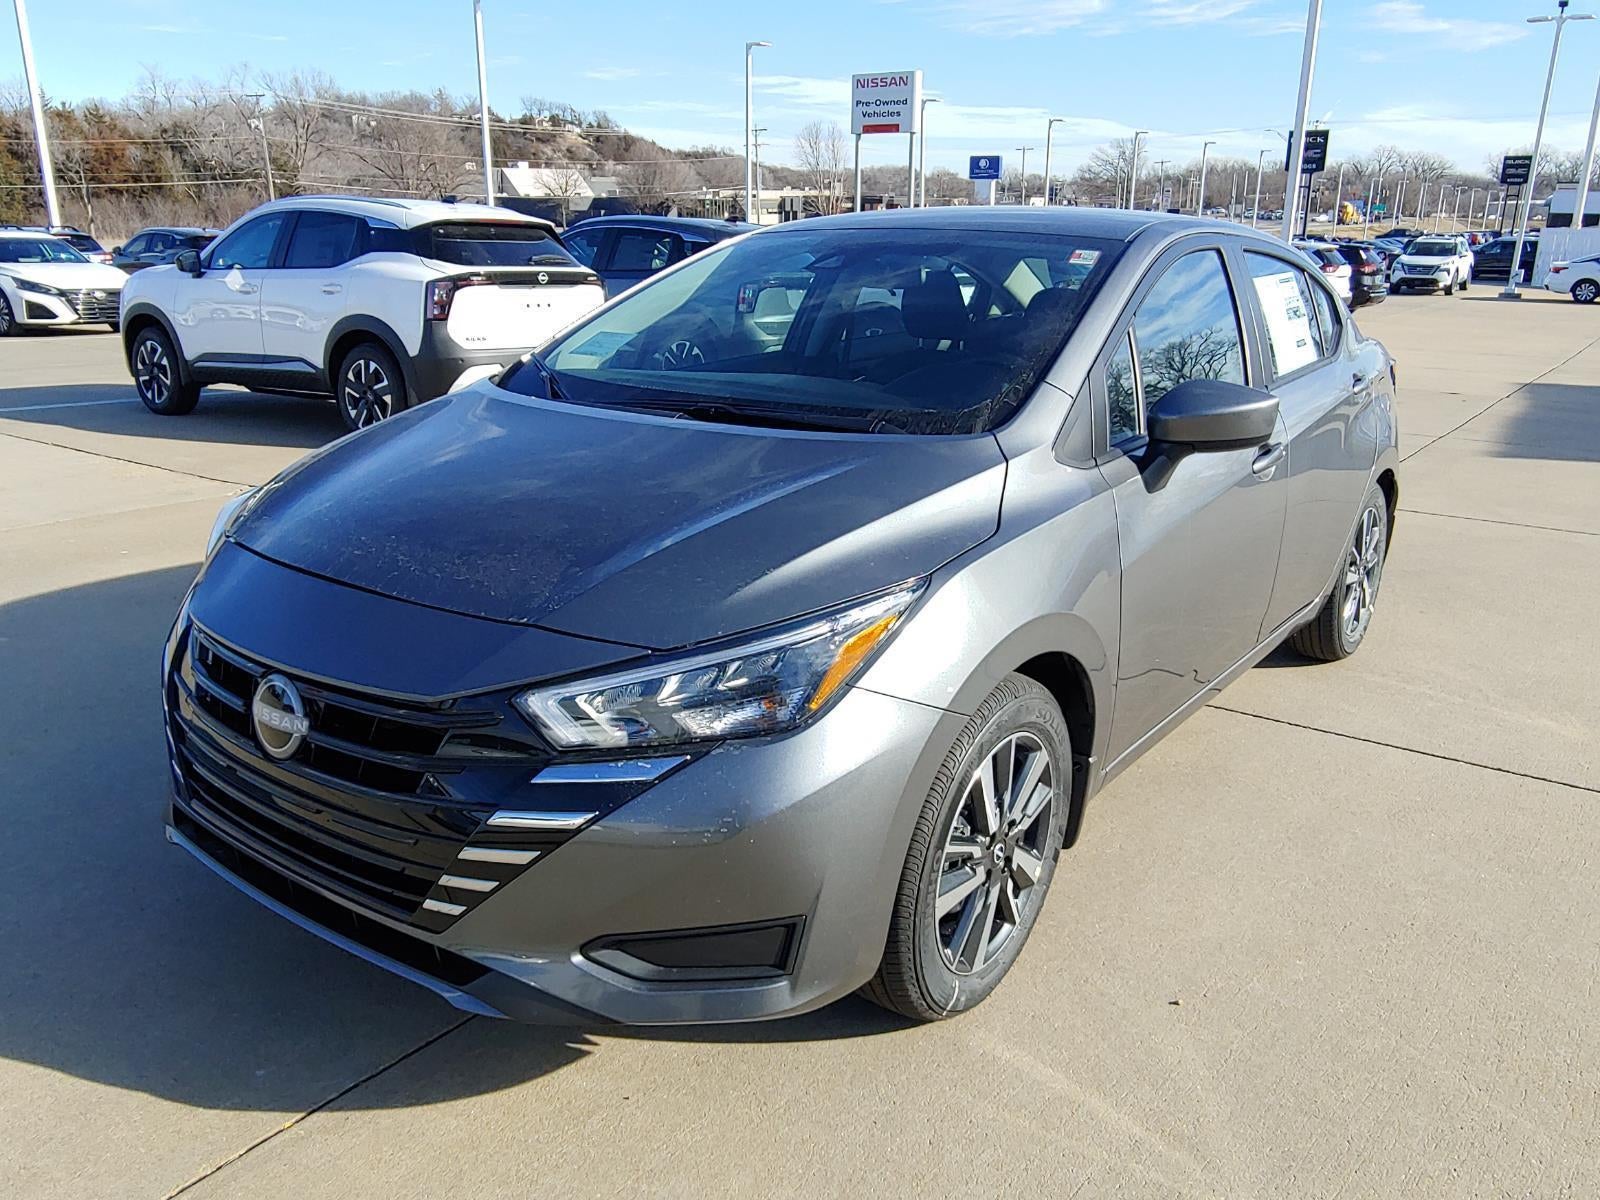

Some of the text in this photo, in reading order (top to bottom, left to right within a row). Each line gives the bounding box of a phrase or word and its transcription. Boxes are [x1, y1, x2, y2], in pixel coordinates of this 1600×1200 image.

[856, 76, 908, 89] NISSAN
[855, 98, 908, 108] Pre-Owned
[861, 110, 901, 119] Vehicles
[255, 701, 306, 732] ISSAN
